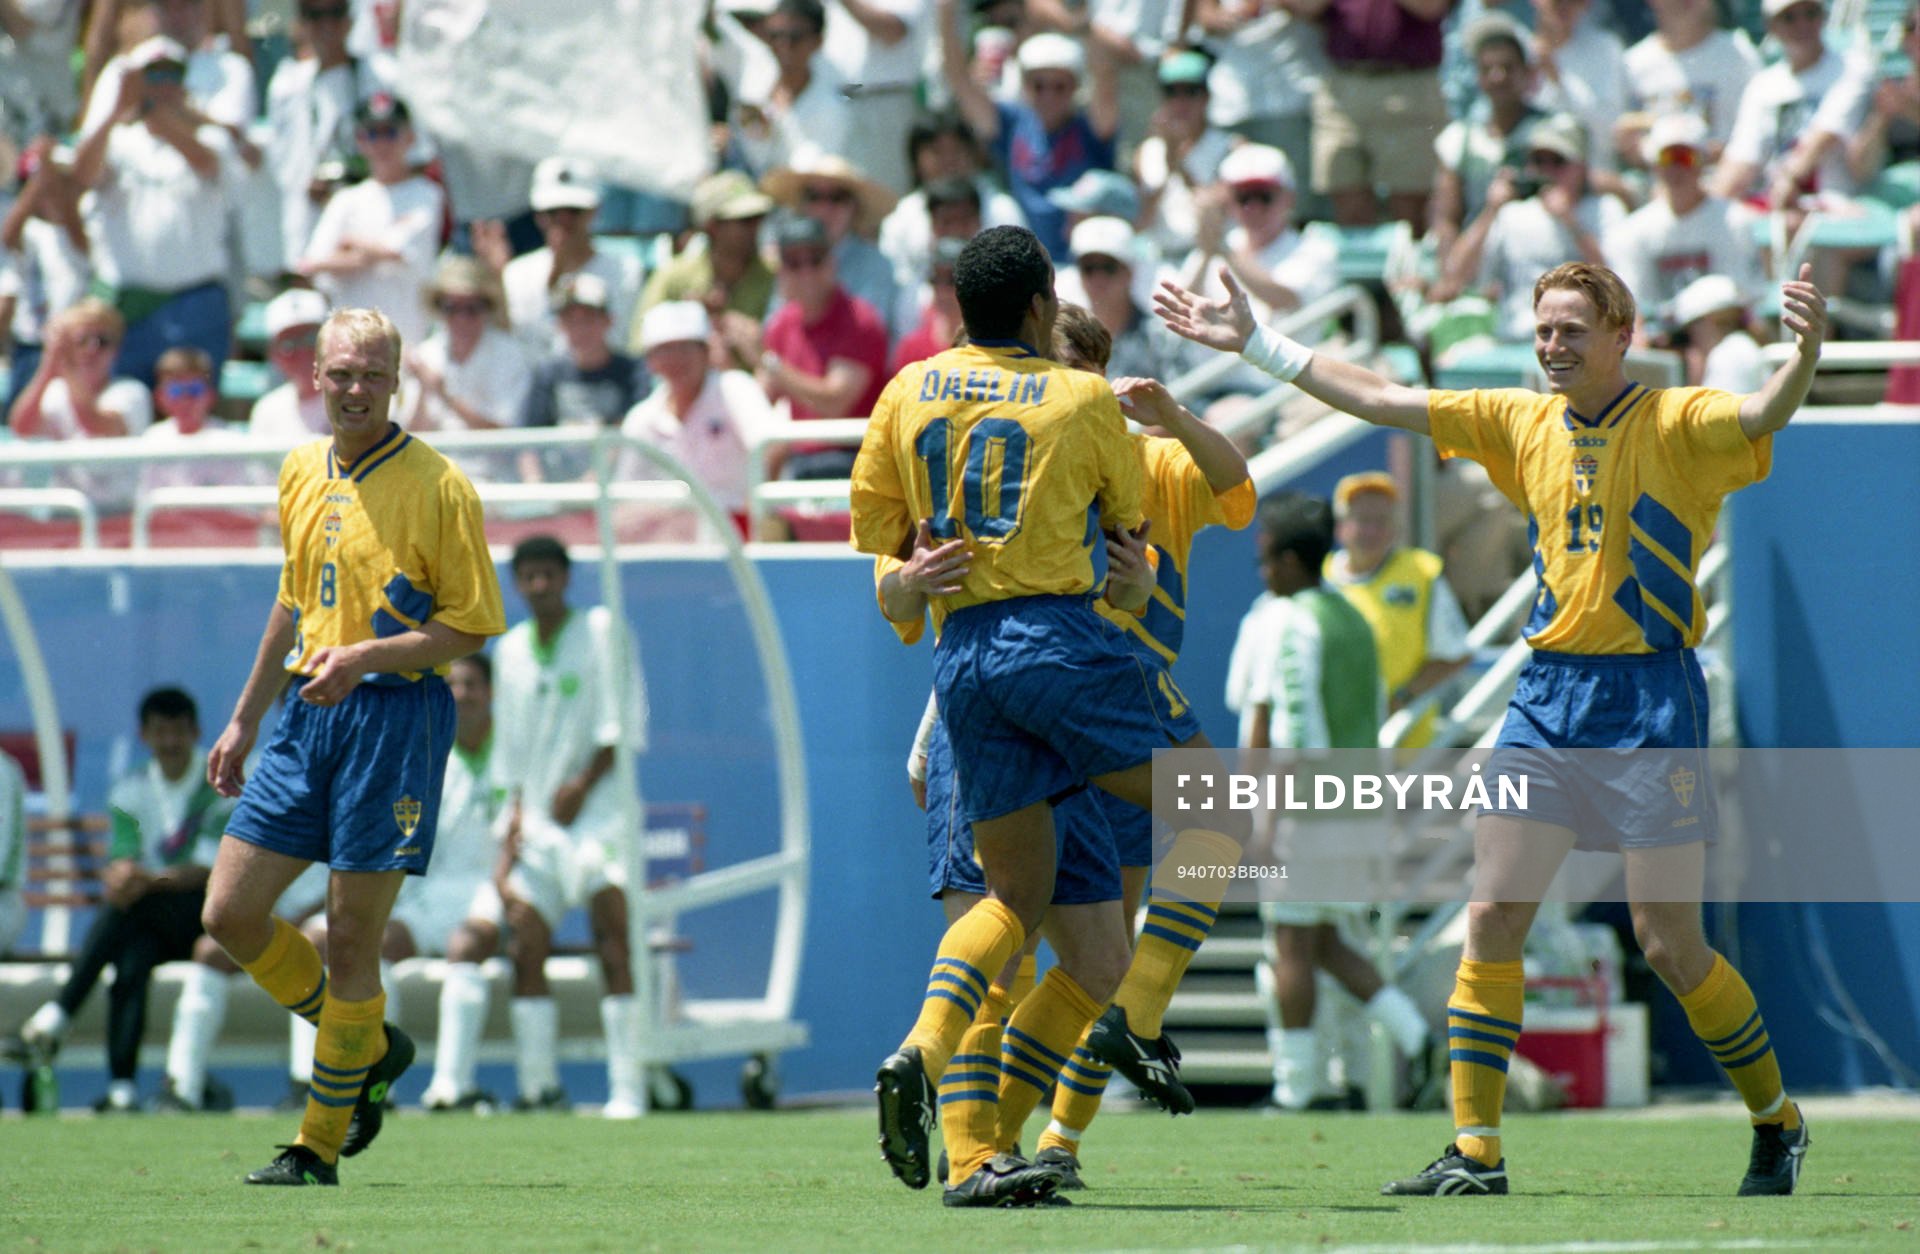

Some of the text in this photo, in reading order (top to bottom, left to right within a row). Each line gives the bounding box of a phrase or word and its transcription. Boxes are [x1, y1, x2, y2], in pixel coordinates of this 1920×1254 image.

[920, 368, 1048, 406] DAHLIN
[915, 417, 1035, 545] 10
[1566, 504, 1604, 553] 19
[320, 562, 336, 607] 8
[1157, 671, 1190, 719] 1
